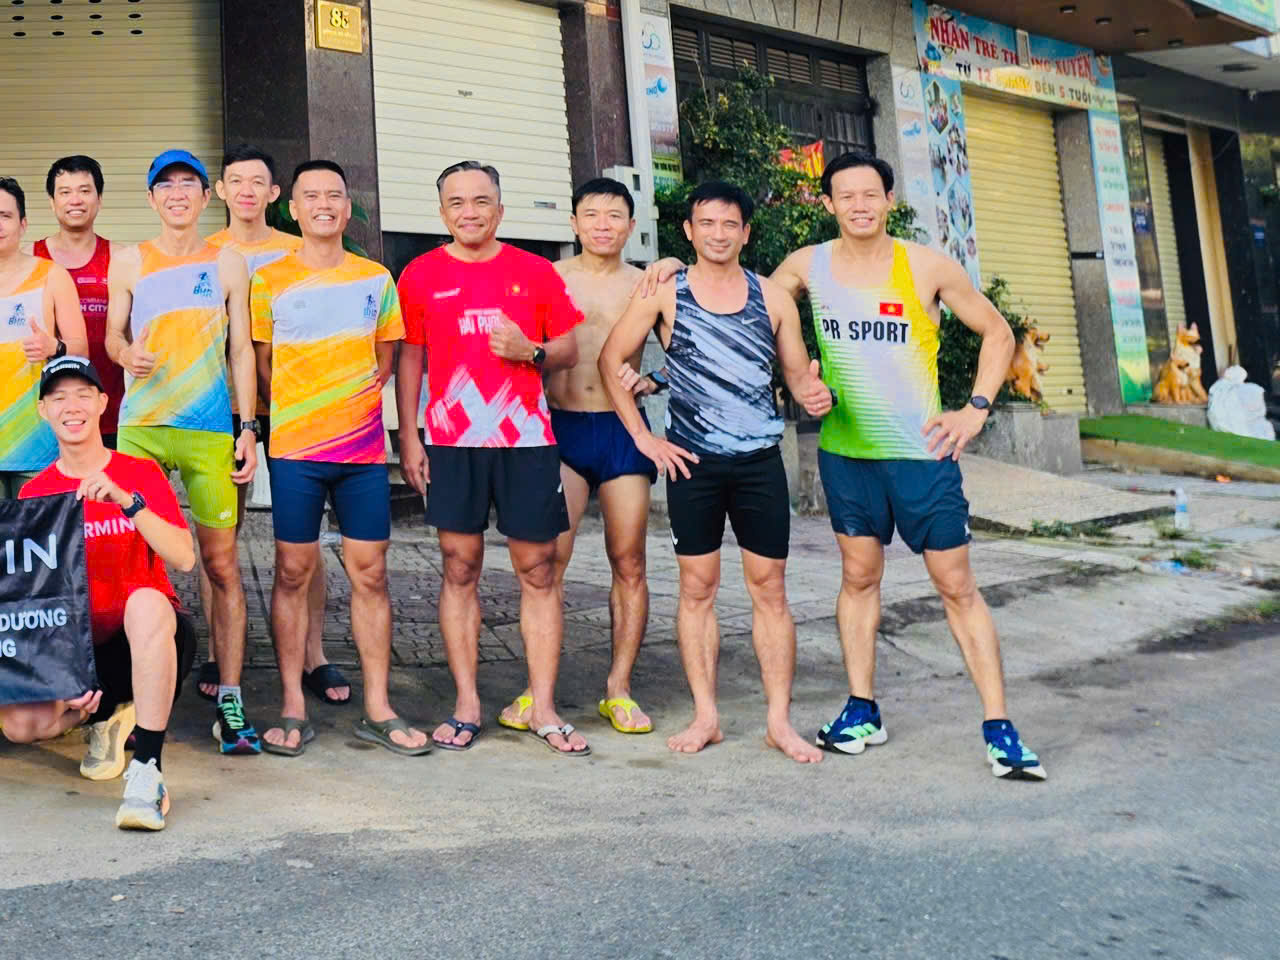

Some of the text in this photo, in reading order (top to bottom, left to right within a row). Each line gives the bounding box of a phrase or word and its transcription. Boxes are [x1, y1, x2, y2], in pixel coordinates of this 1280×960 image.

[973, 36, 999, 60] TRẺ
[1001, 48, 1053, 73] THNG
[977, 67, 992, 82] 12
[1059, 84, 1066, 98] 5
[822, 318, 909, 345] PR SPORT
[83, 517, 137, 539] RMIN
